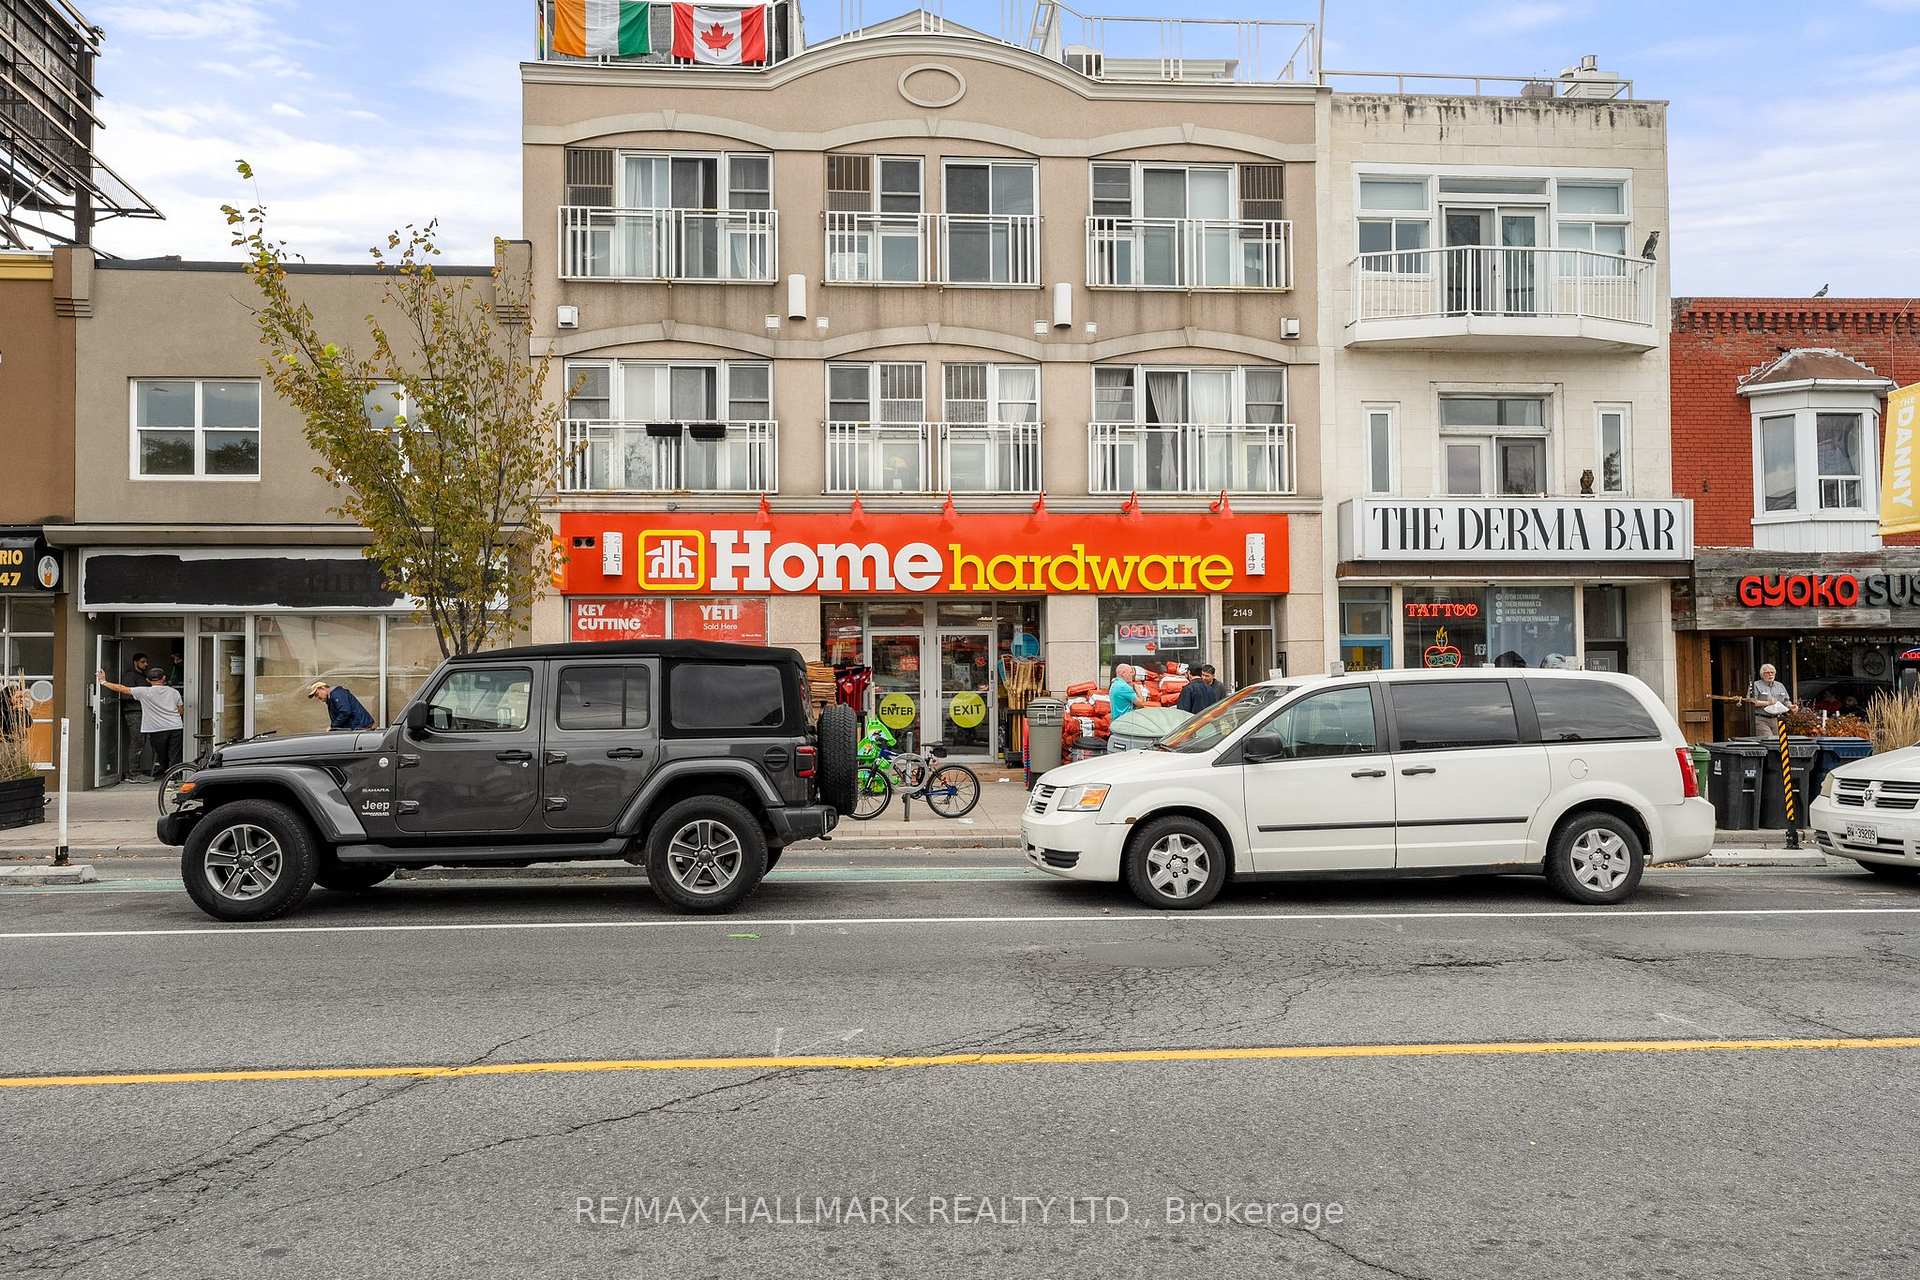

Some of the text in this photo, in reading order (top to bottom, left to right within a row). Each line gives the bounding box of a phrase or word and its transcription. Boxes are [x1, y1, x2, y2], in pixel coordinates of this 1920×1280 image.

[1892, 406, 1915, 508] DANNY
[1373, 507, 1675, 550] THE DERMA BAR
[711, 530, 943, 592] Home
[948, 543, 1234, 591] hardware
[1739, 575, 1859, 607] GYOKO
[578, 604, 606, 617] KEY
[700, 605, 738, 620] YETI
[1233, 608, 1253, 617] 2149
[1405, 603, 1478, 617] TATTOO
[578, 618, 641, 631] CUTTING
[703, 622, 738, 631] Sold Here
[1120, 623, 1156, 639] OPEN
[1161, 624, 1194, 635] FedEx
[881, 705, 914, 716] ENTER
[953, 704, 982, 716] EXIT
[362, 800, 390, 811] Jeep
